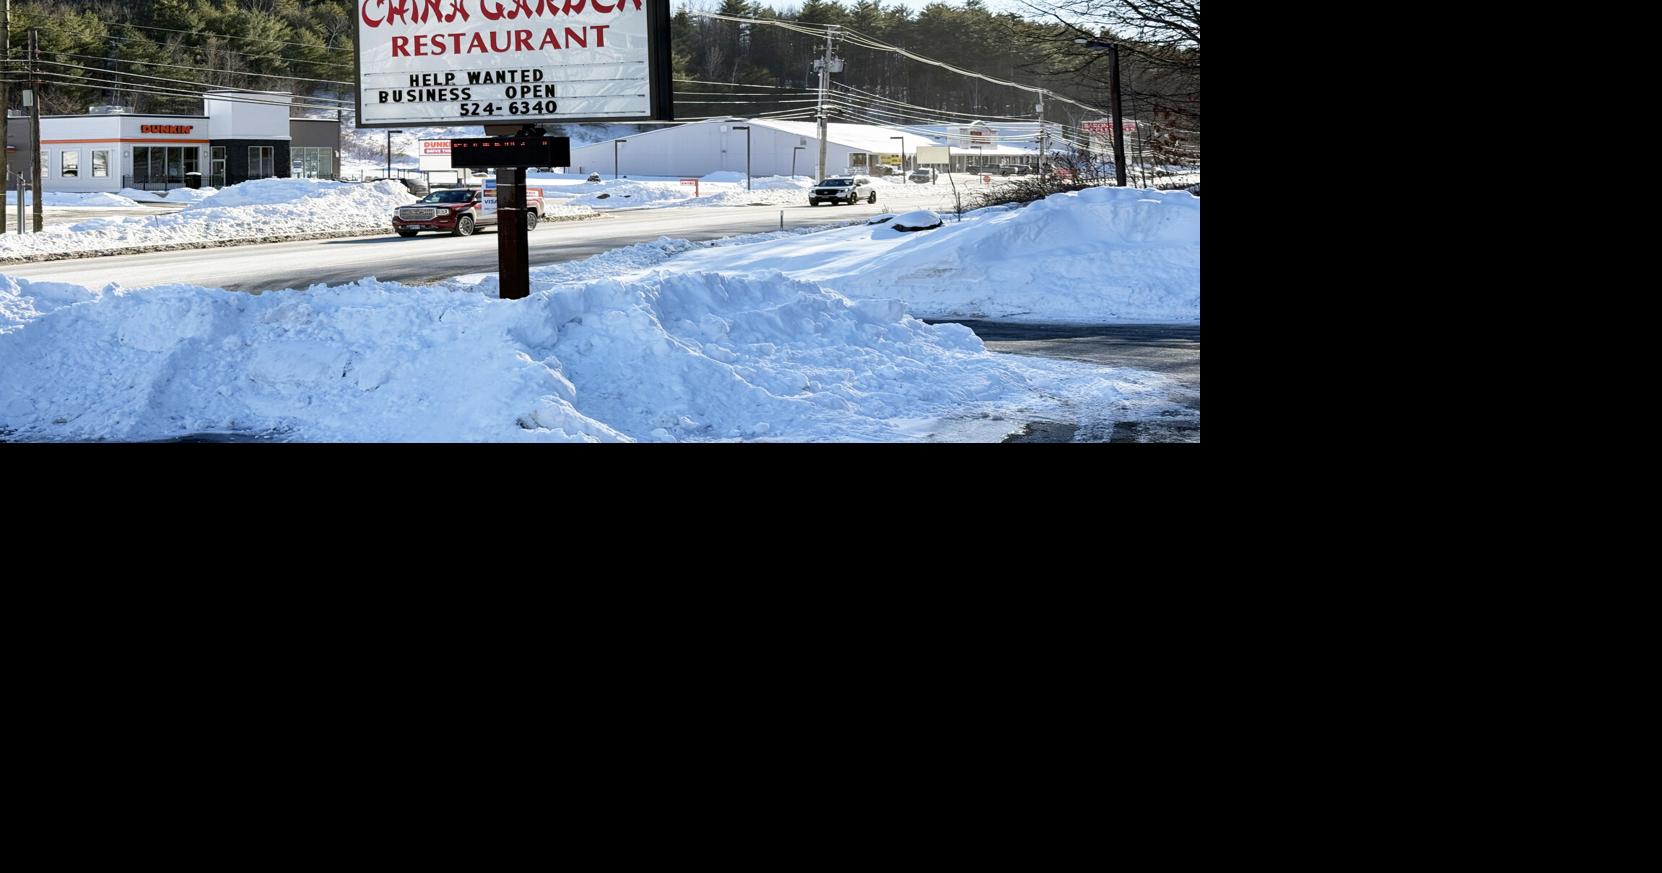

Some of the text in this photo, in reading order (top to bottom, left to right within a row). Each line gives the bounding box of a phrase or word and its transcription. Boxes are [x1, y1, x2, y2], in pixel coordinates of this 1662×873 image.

[391, 25, 609, 58] RESTAURANT
[409, 68, 544, 87] HELP WANTED
[378, 84, 556, 103] BUSINESS OPEN
